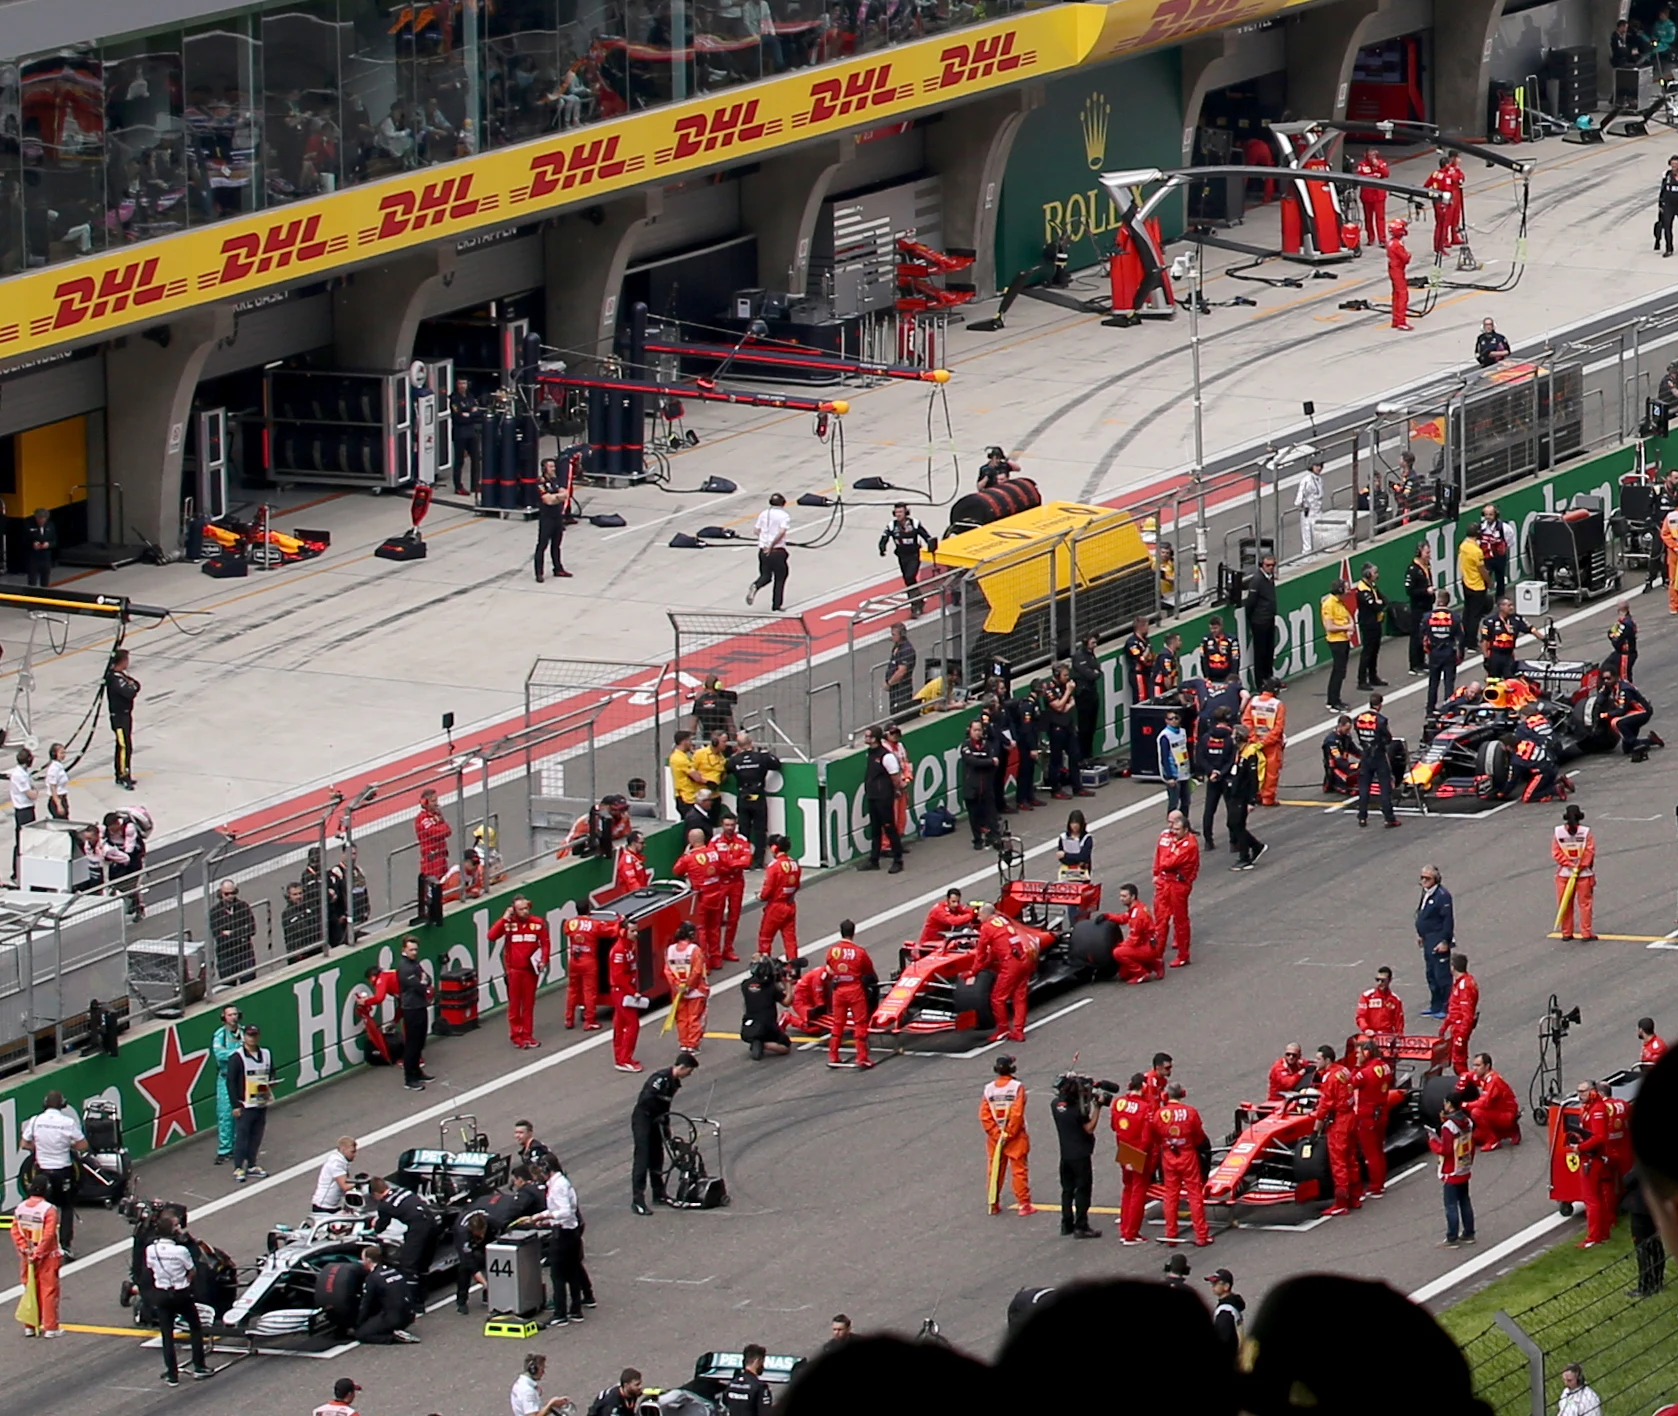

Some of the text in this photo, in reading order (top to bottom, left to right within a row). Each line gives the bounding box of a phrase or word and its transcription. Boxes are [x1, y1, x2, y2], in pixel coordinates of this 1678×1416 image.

[938, 31, 1023, 89] DHL
[808, 63, 897, 124] DHL
[672, 98, 766, 160] DHL
[528, 135, 627, 199] DHL
[377, 172, 482, 240] DHL
[218, 214, 329, 284] DHL
[52, 257, 167, 331] DHL
[489, 1258, 514, 1278] 44
